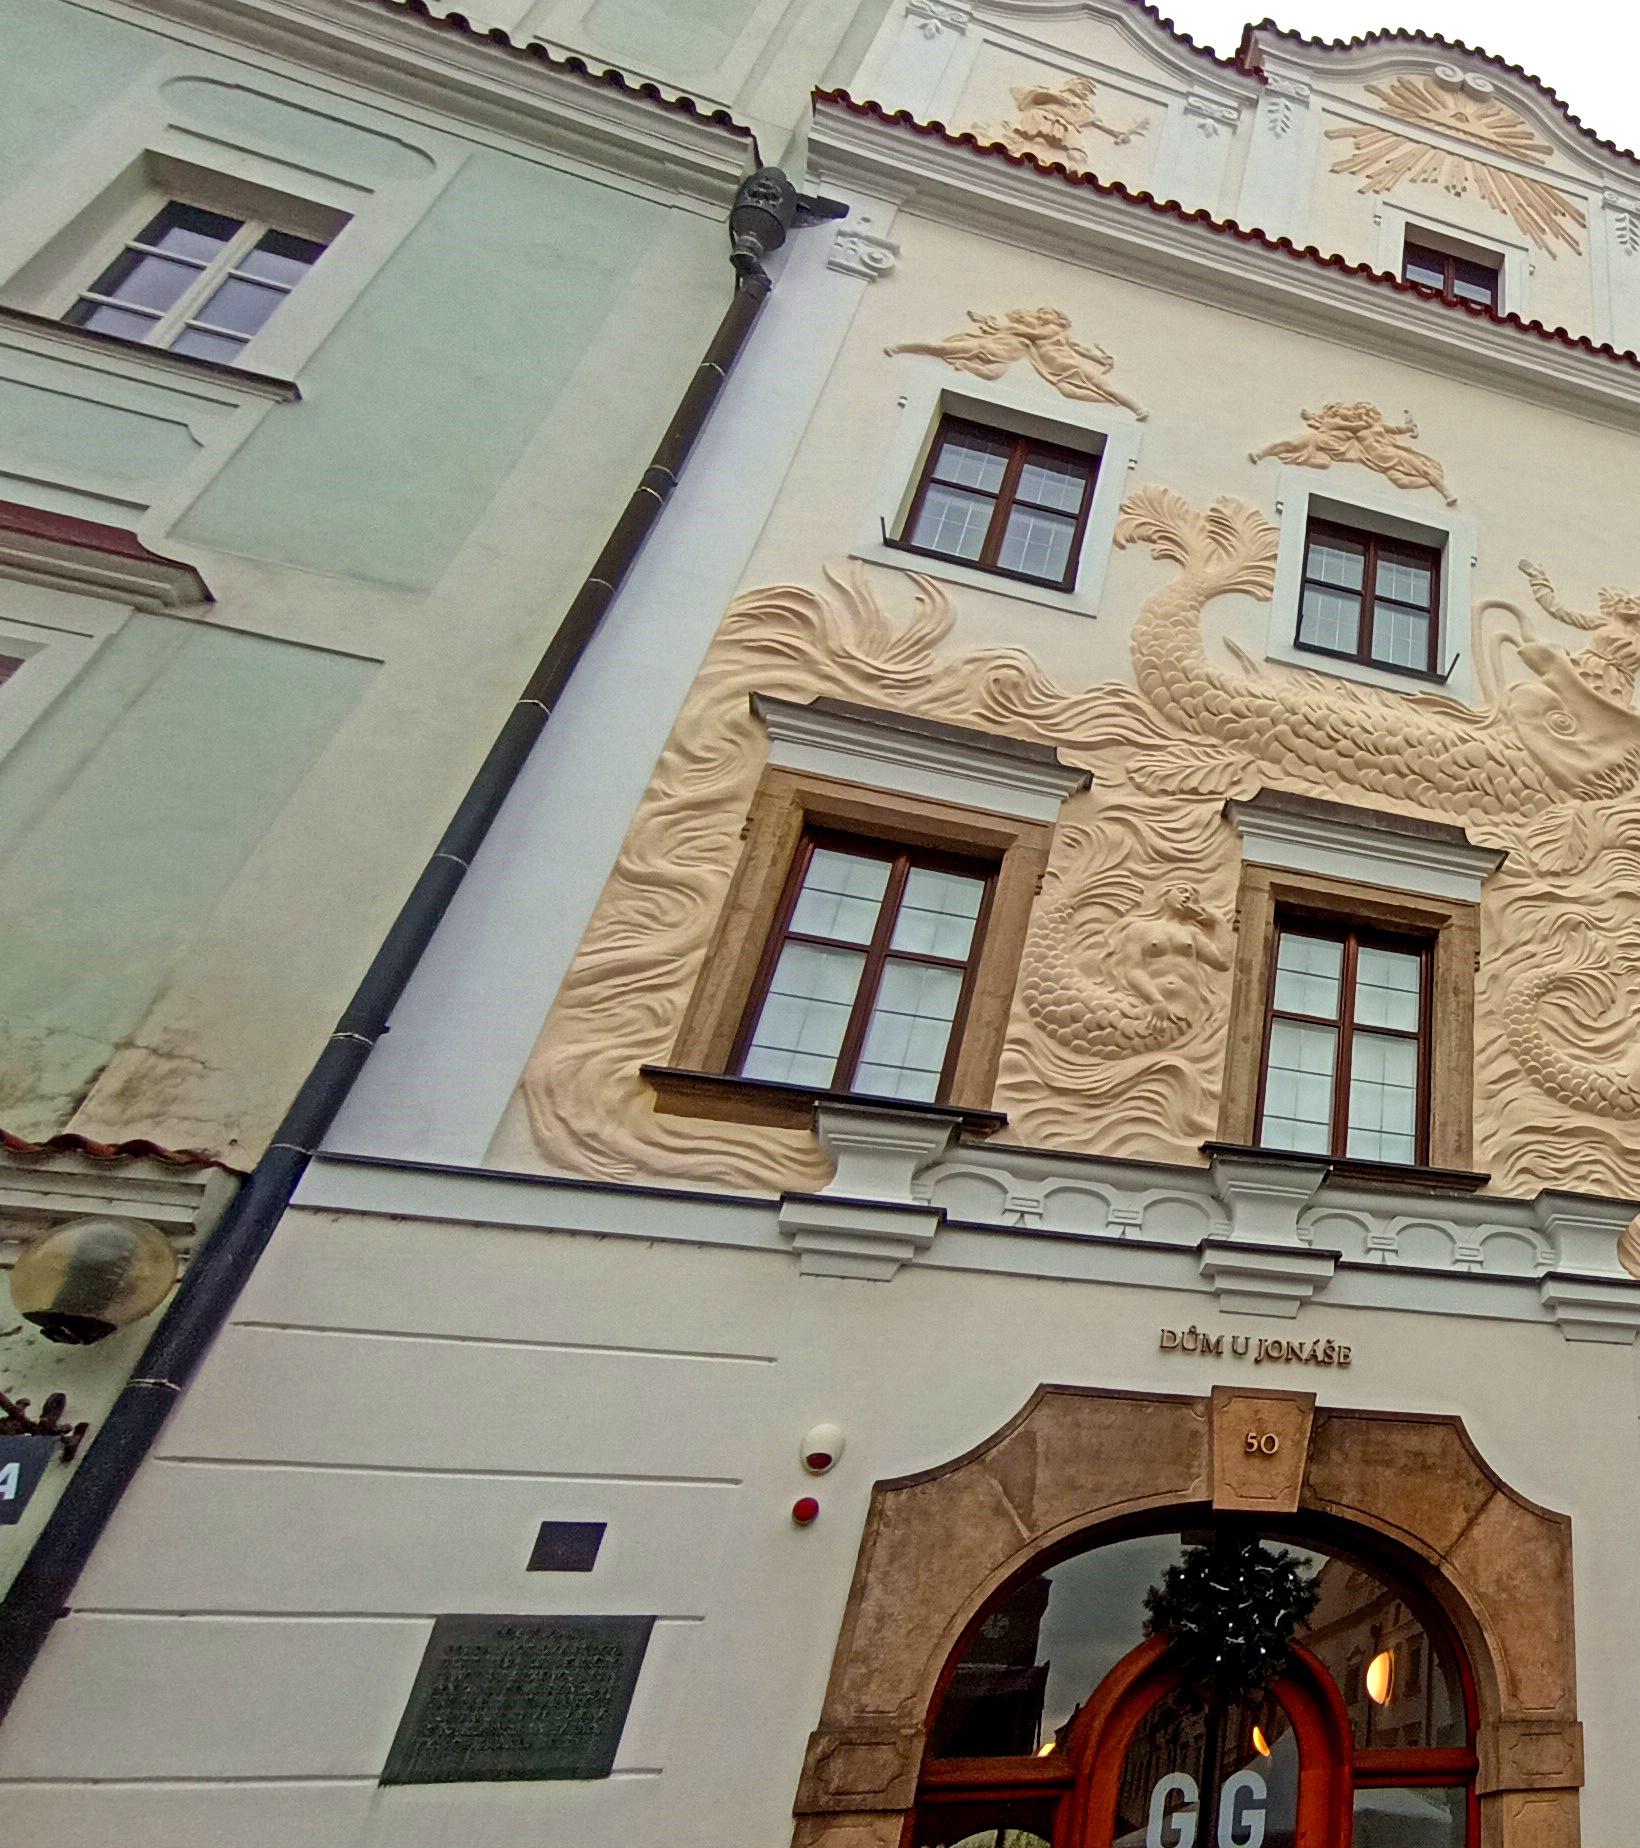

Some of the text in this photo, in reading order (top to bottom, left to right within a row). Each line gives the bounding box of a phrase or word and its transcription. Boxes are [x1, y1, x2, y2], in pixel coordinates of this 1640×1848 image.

[1159, 1325, 1352, 1365] DŮM U JONÁŠE
[1245, 1432, 1279, 1455] 50
